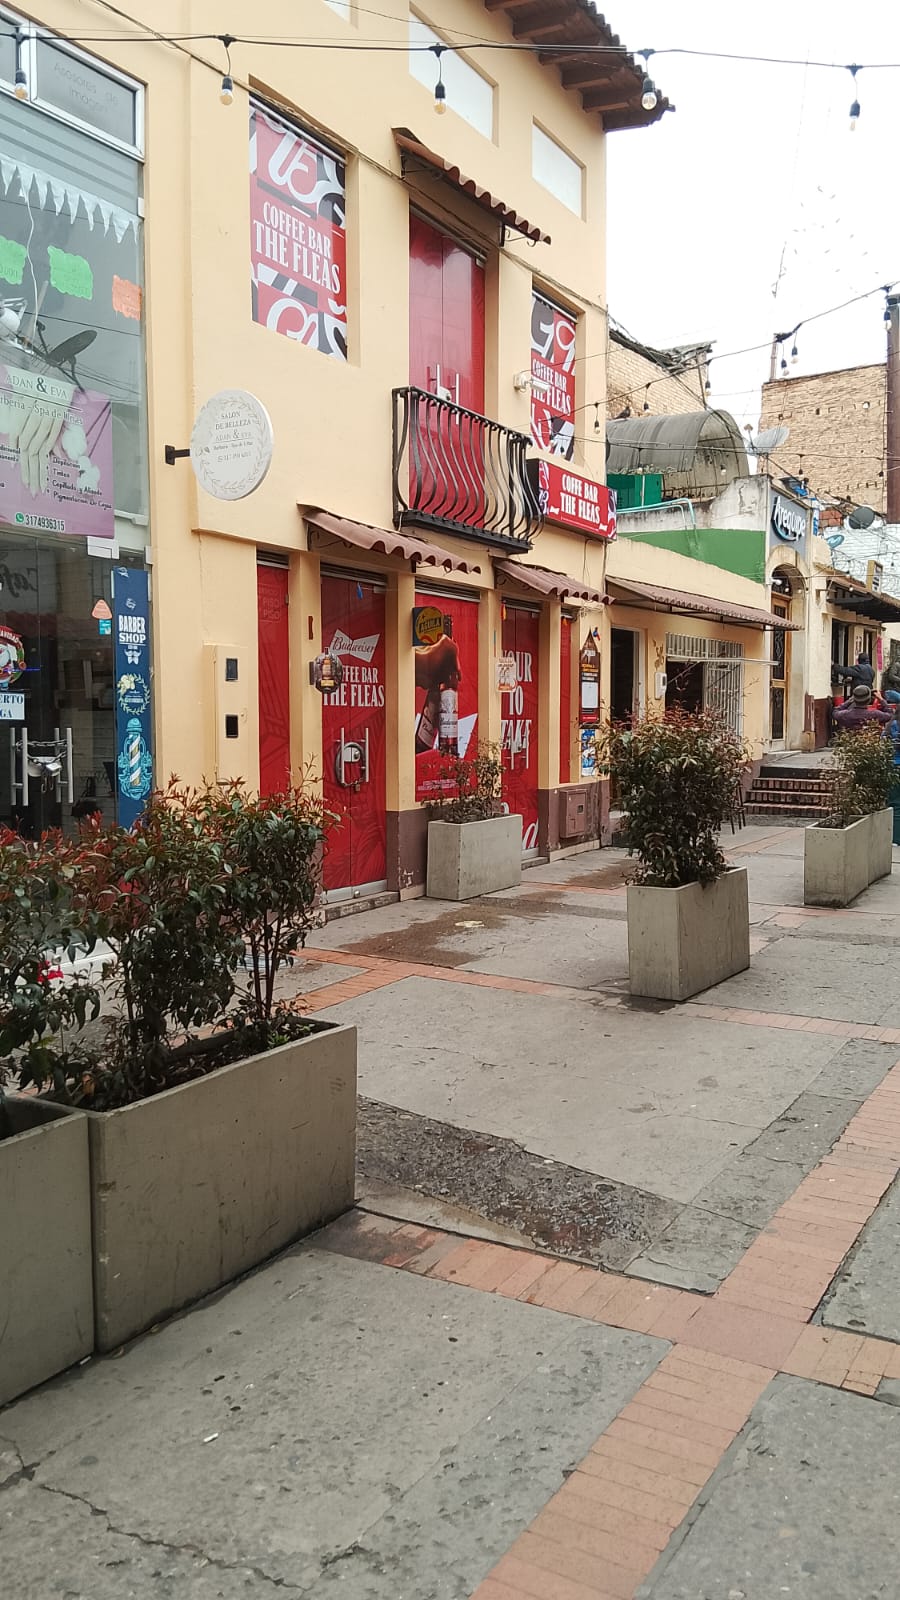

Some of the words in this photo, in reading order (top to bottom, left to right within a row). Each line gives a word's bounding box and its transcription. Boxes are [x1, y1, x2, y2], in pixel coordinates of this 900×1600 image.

[263, 201, 306, 244] COFFEE
[308, 225, 331, 259] BAR
[253, 219, 288, 268] THE
[293, 241, 341, 294] FLEAS
[7, 375, 33, 389] ADAN
[36, 376, 47, 393] &
[51, 387, 68, 400] EVA
[532, 358, 554, 385] COFFEE
[554, 371, 567, 393] BAR
[546, 385, 571, 417] FLEAS
[583, 483, 598, 504] BAR
[560, 492, 576, 516] THE
[578, 499, 600, 525] FLEAS
[119, 615, 146, 634] BARBER
[119, 633, 146, 644] SHOP
[333, 636, 375, 654] Budweiser
[339, 665, 361, 683] FFEE
[361, 667, 379, 684] BAR
[350, 684, 385, 707] FLEAS
